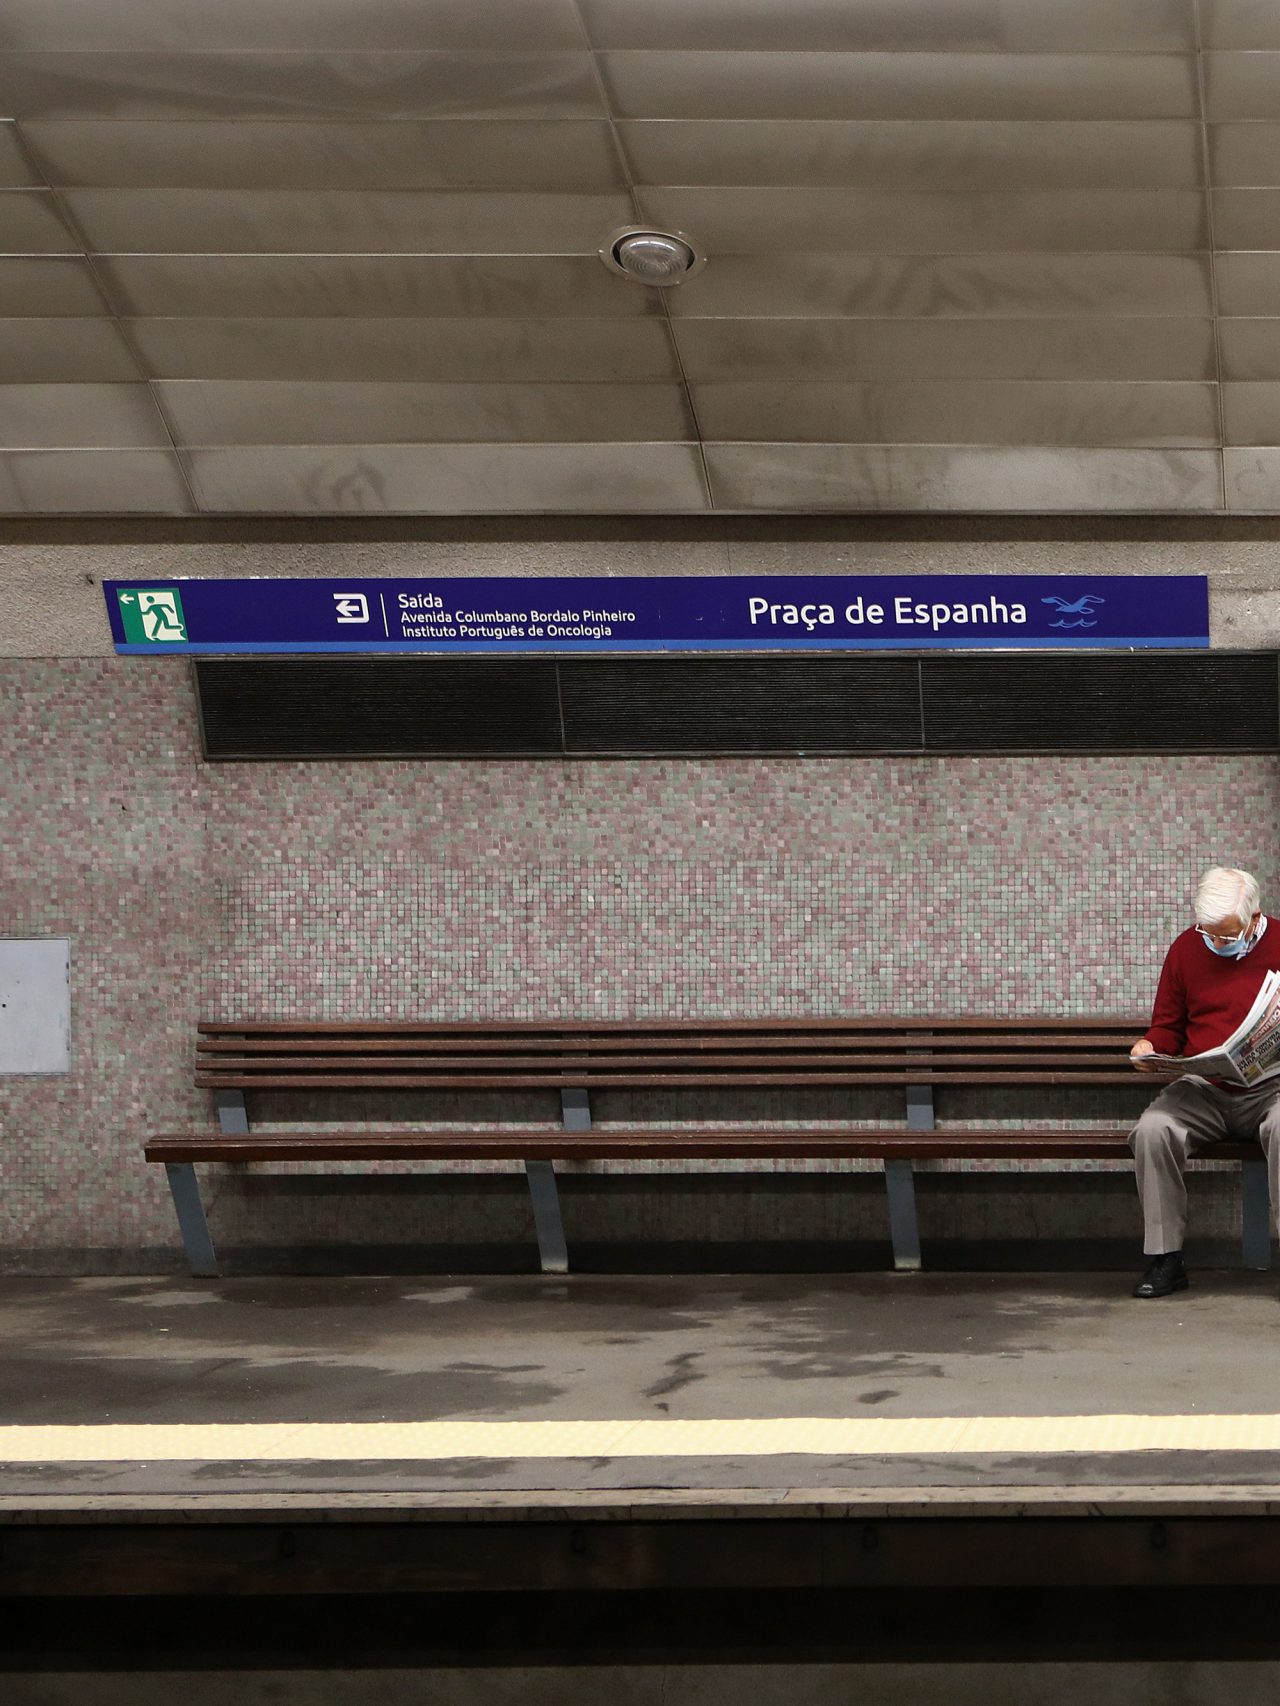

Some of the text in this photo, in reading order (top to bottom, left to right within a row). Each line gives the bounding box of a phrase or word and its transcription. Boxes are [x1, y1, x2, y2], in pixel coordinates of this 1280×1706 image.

[398, 593, 443, 608] Saída
[401, 609, 636, 623] Avenida Columbano Bordalo Pinheiro
[749, 596, 1027, 631] Praça de Espanha
[402, 623, 612, 640] Instituto Português de Oncologia
